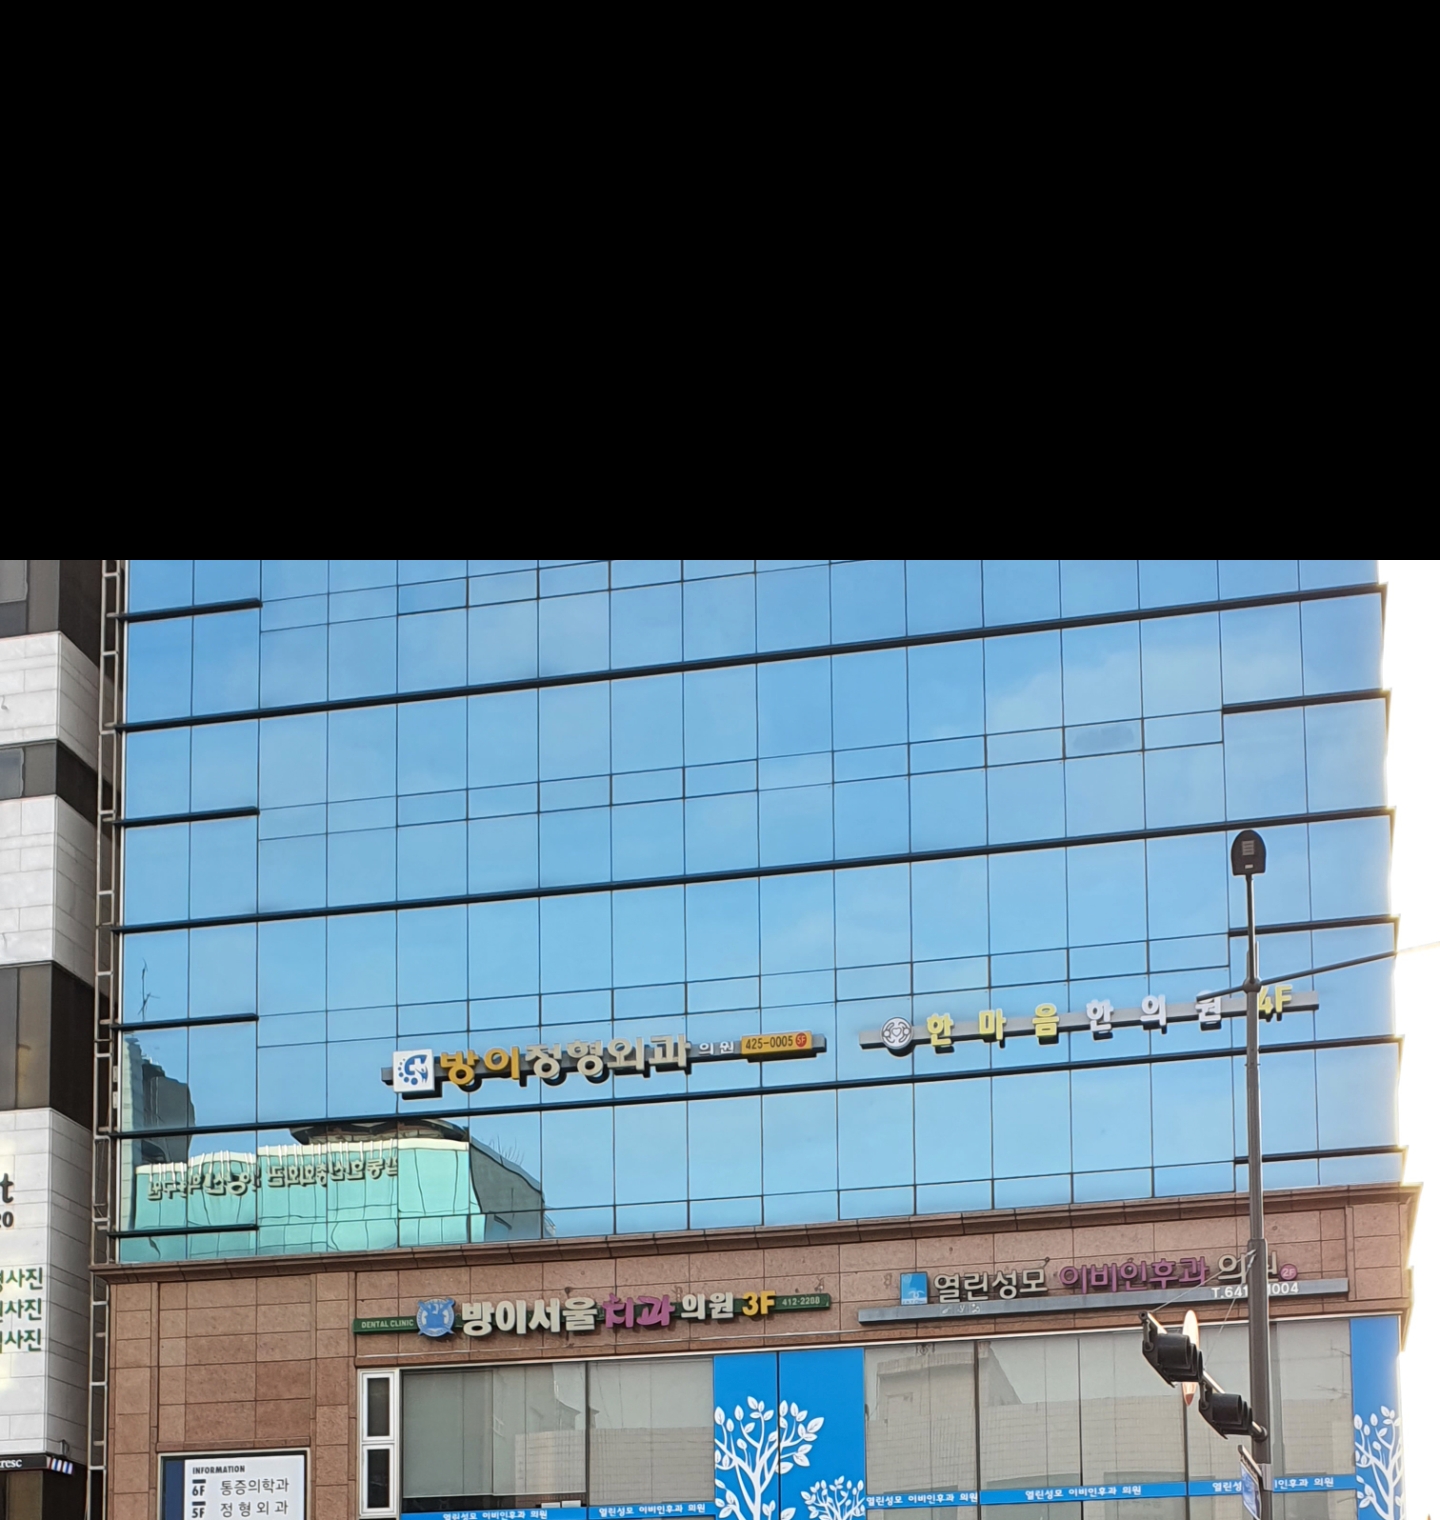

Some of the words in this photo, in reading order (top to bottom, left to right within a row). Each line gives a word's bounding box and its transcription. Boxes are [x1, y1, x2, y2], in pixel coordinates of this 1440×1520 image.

[698, 1041, 735, 1056] 의원
[745, 1036, 793, 1050] 425-0005
[933, 1266, 1049, 1304] 열린성모
[1058, 1255, 1211, 1295] 이비인후과
[1211, 1282, 1299, 1300] T.6411004
[0, 1298, 42, 1322] 사진
[681, 1291, 734, 1320] 의원
[742, 1291, 776, 1316] 3F
[361, 1322, 389, 1330] DENTAL
[390, 1319, 414, 1328] CLINIC
[0, 1328, 42, 1353] 사진
[192, 1465, 245, 1474] INFORMATION
[192, 1485, 205, 1496] 6F
[220, 1478, 289, 1496] 통증의학과
[1313, 1477, 1335, 1488] 의원
[866, 1494, 903, 1506] 열린성모
[907, 1493, 955, 1504] 이비인후과
[959, 1491, 979, 1503] 의원
[1025, 1488, 1064, 1500] 열린성모
[1068, 1486, 1117, 1498] 이비인후과
[1122, 1484, 1142, 1496] 의원
[191, 1508, 205, 1518] 5F
[482, 1508, 526, 1520] 이비인후과
[529, 1508, 549, 1520] 의원
[598, 1504, 634, 1517] 열린성모
[639, 1503, 684, 1515] 이비인후과
[688, 1502, 707, 1514] 의원
